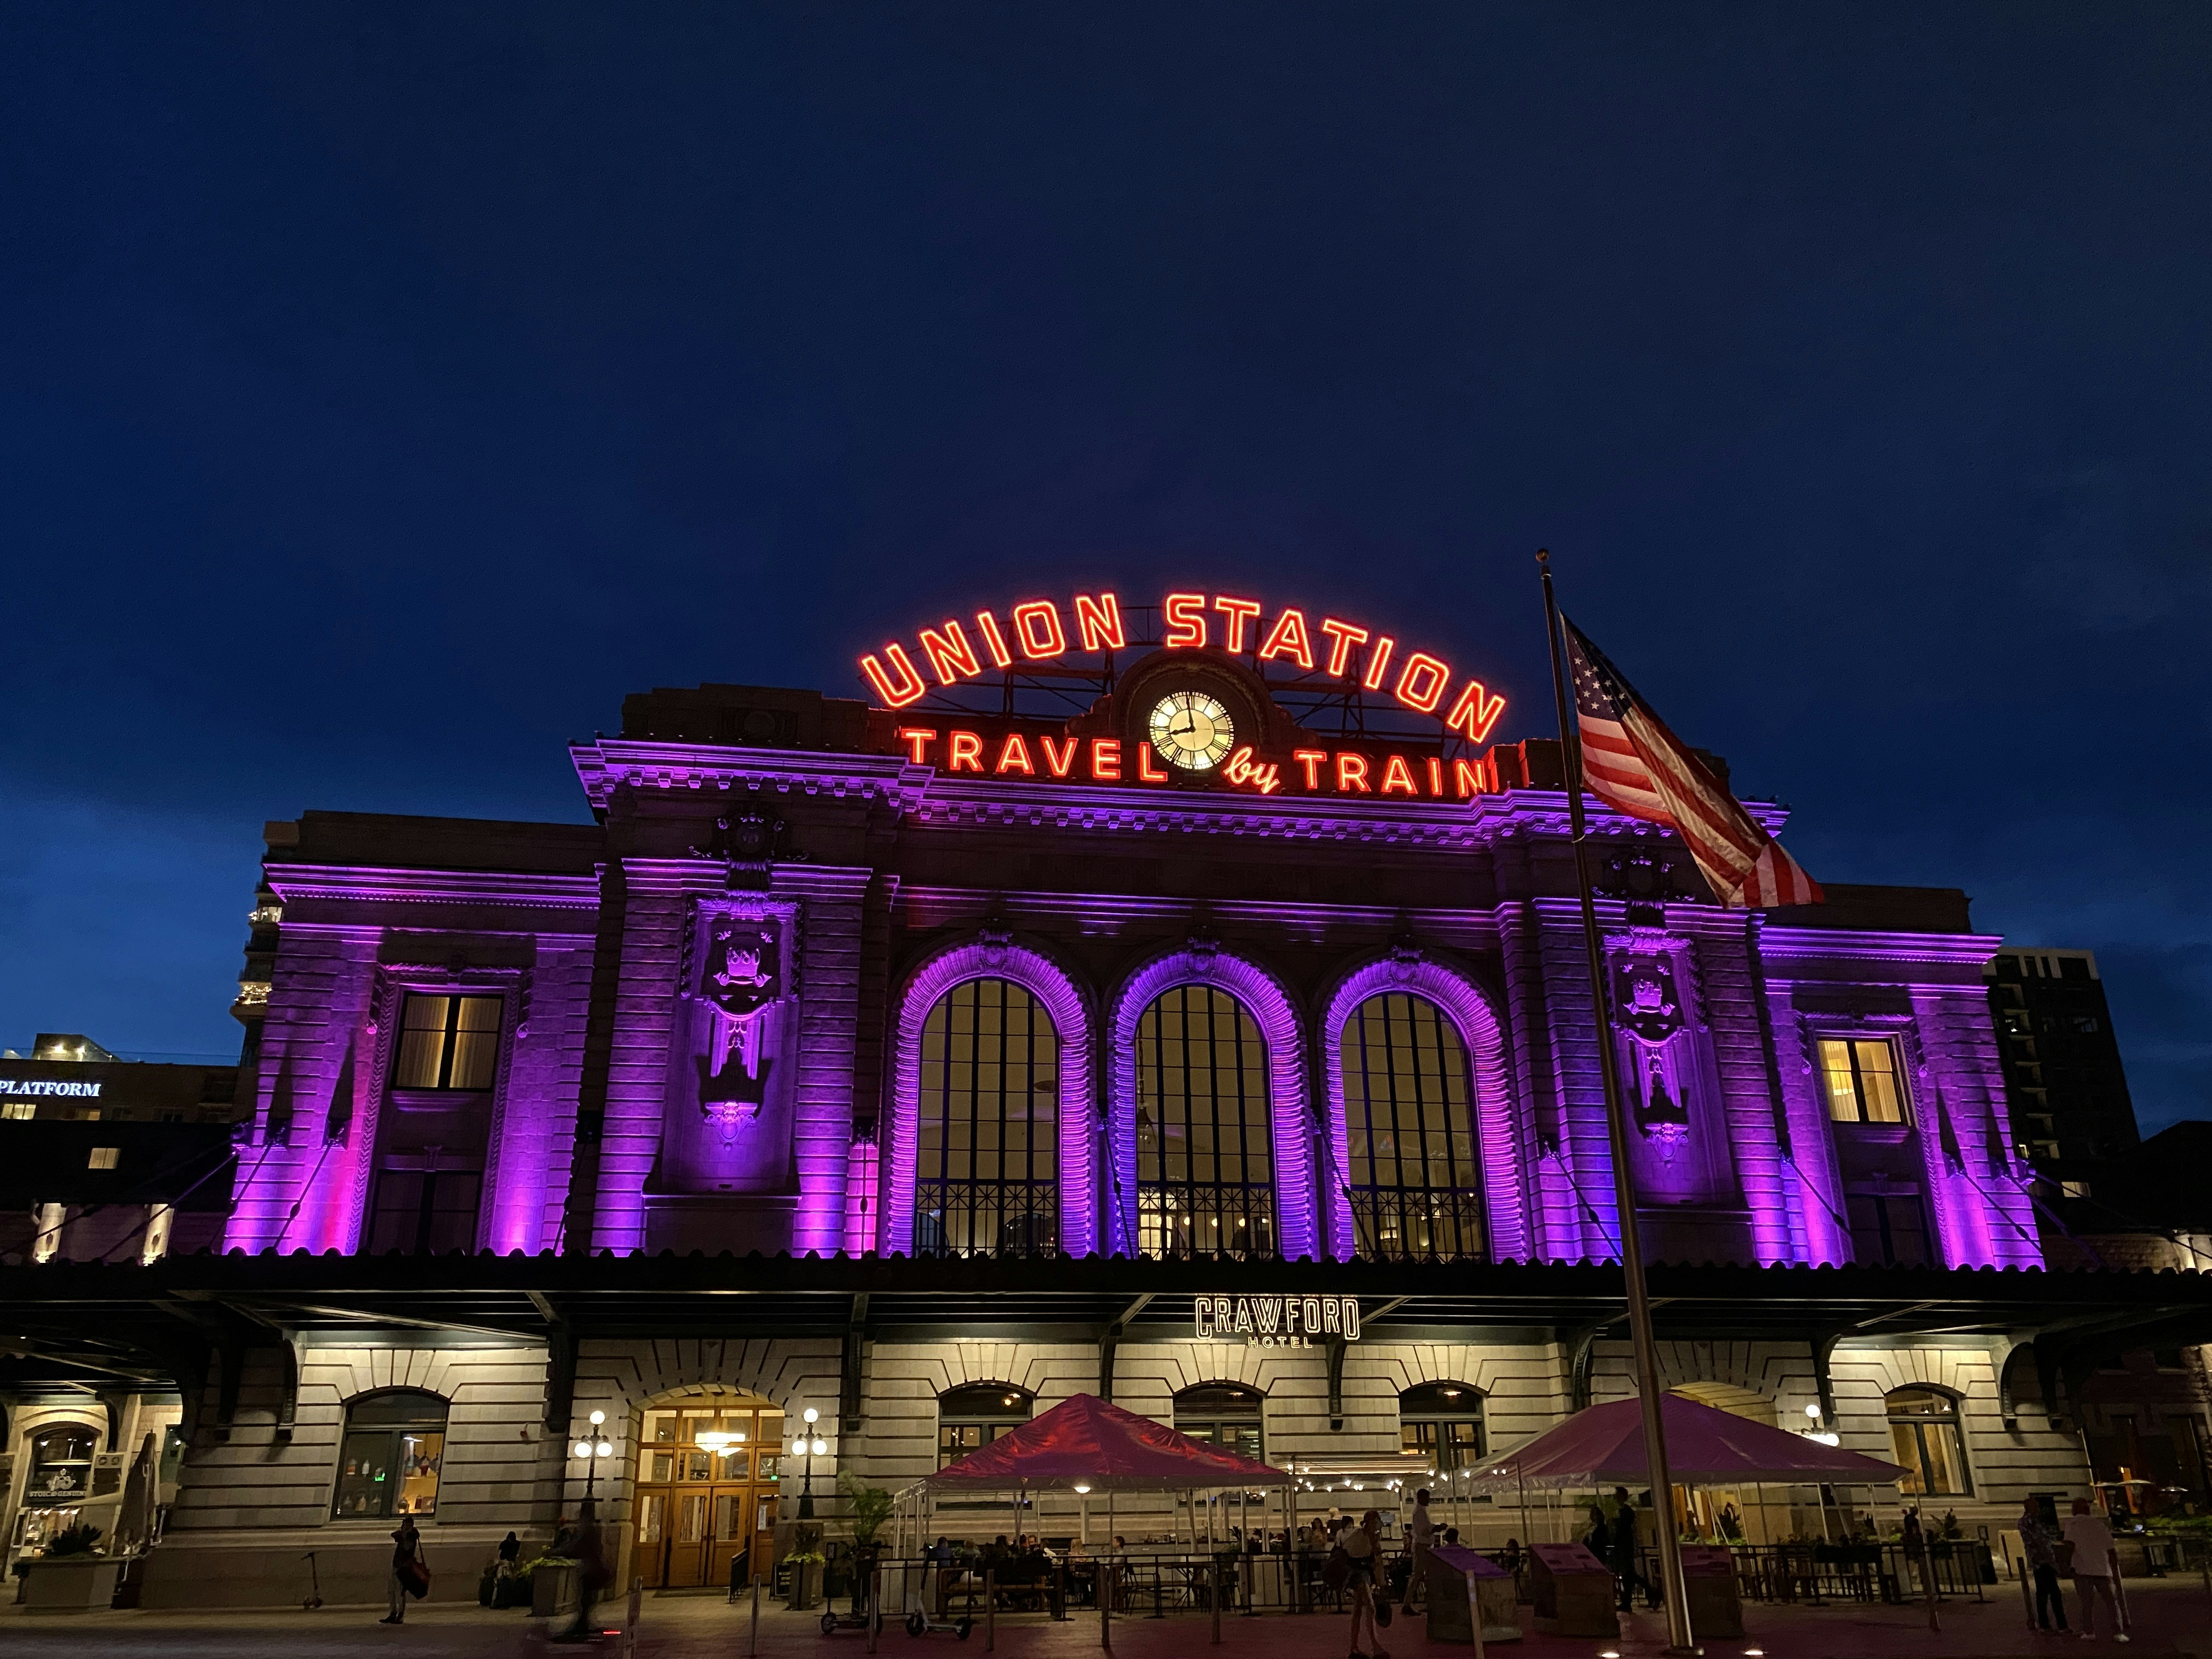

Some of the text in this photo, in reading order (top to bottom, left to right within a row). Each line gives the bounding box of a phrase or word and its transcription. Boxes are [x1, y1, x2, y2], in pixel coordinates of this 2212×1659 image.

[861, 592, 1506, 744] UNION STATION
[900, 729, 1487, 798] TRAVEL by TRAIN
[0, 1080, 102, 1097] PLATFORM
[1194, 1297, 1361, 1340] CRAWFORD
[1247, 1336, 1313, 1348] HOTEL
